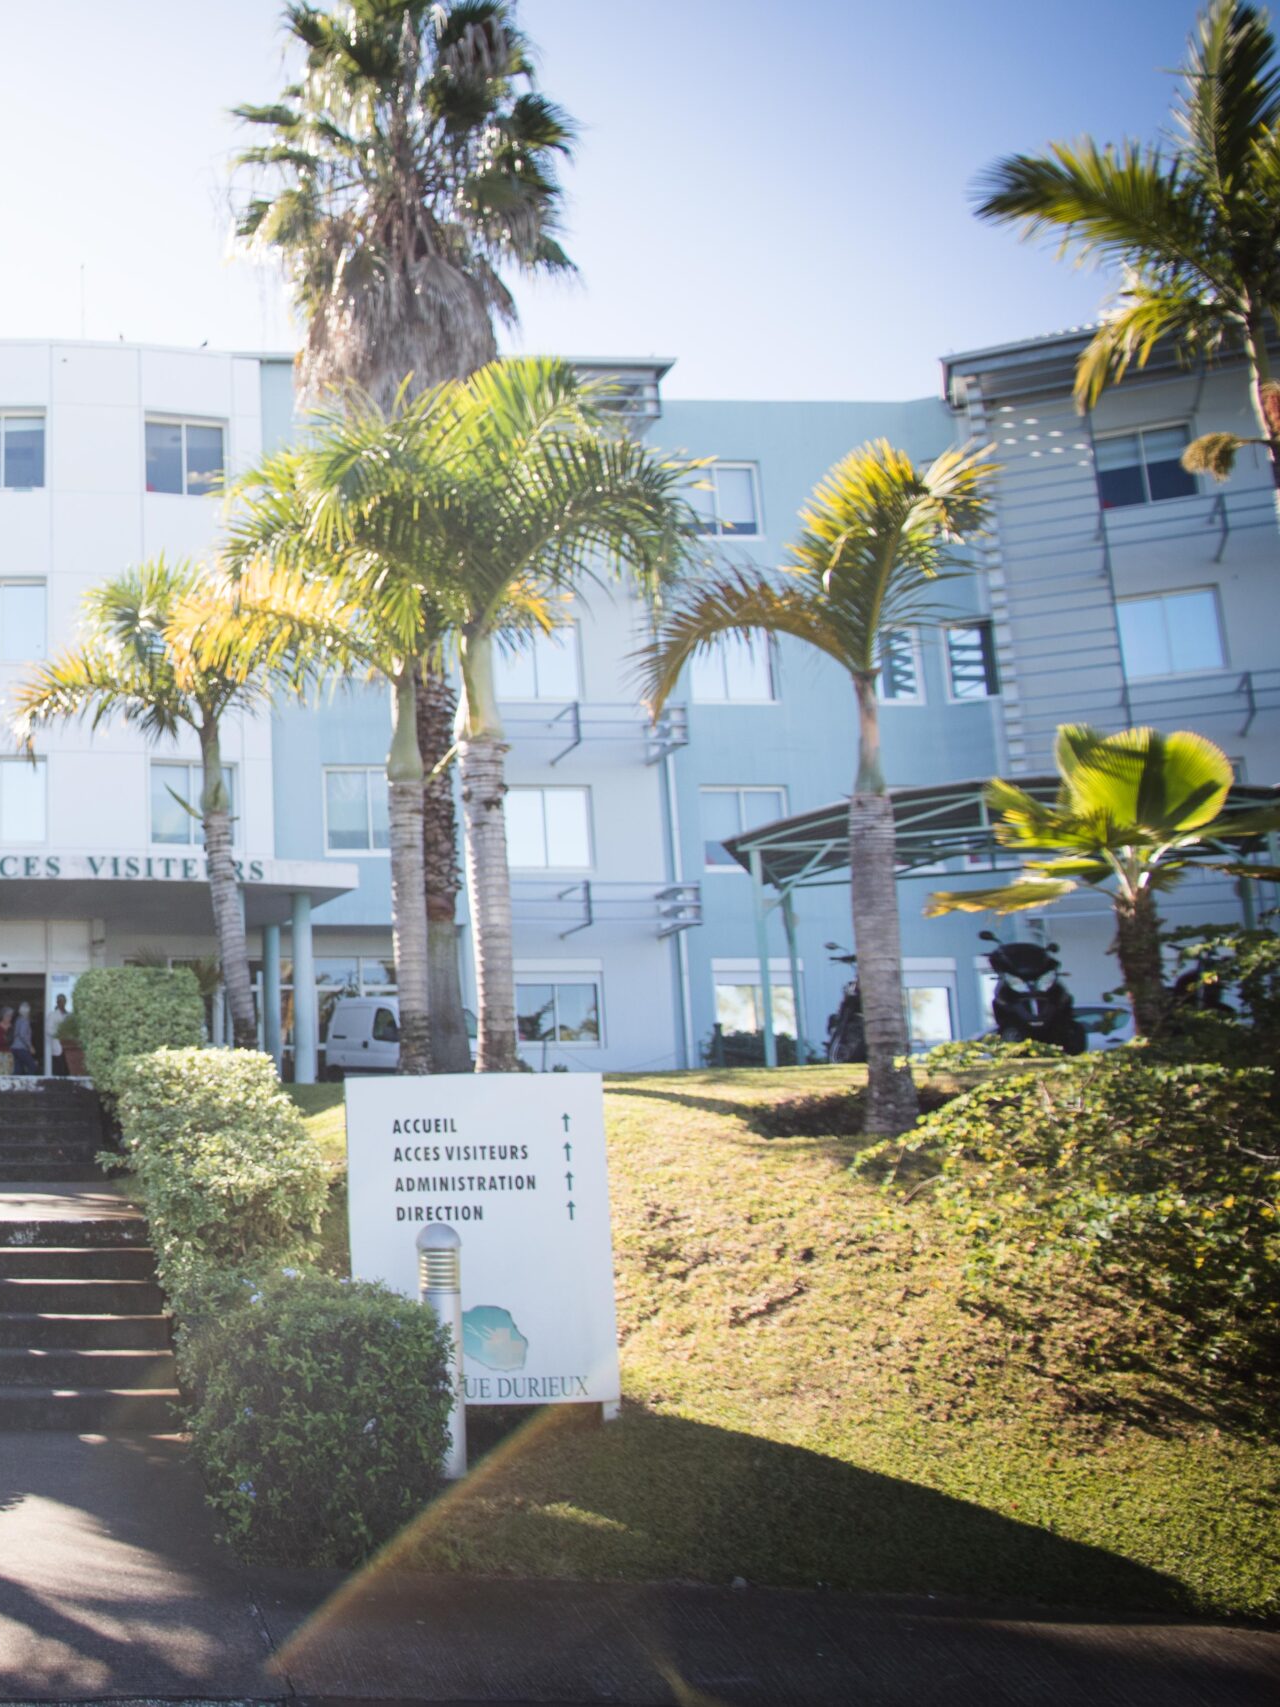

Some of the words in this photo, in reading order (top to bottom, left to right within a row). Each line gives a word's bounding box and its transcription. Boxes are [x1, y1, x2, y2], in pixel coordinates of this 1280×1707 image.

[87, 856, 264, 881] VISITERS
[392, 1118, 457, 1134] ACCUEIL
[393, 1147, 440, 1162] ACCES
[445, 1145, 528, 1161] VISITEURS
[395, 1175, 537, 1192] ADMINISTRATION
[396, 1205, 483, 1221] DIRECTION
[497, 1376, 589, 1398] DURIEUX
